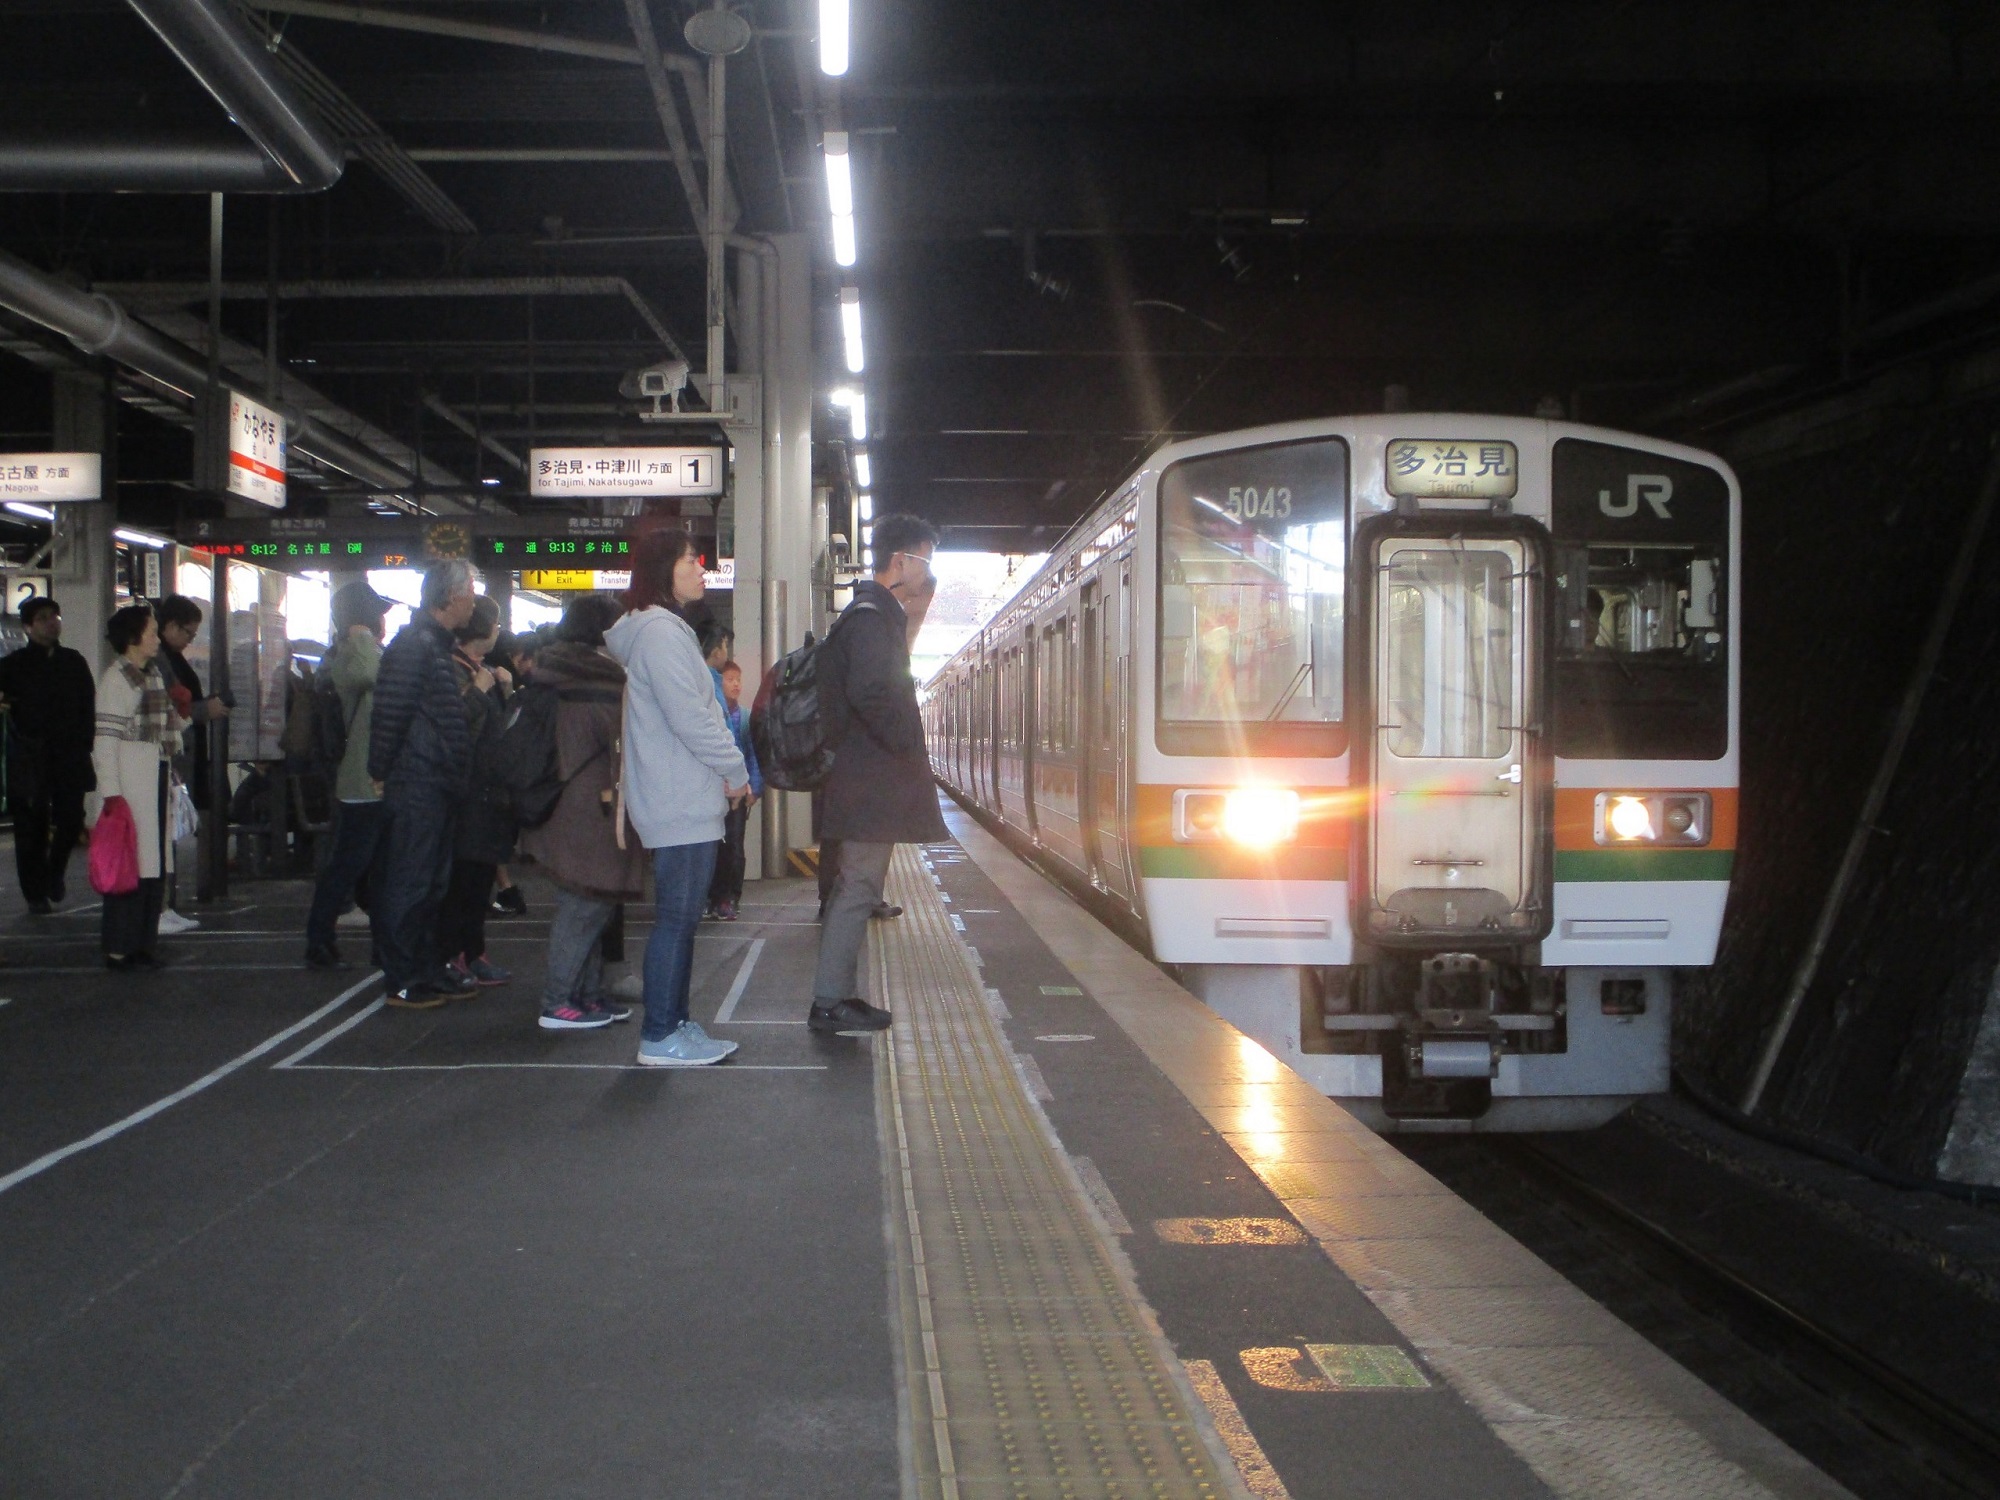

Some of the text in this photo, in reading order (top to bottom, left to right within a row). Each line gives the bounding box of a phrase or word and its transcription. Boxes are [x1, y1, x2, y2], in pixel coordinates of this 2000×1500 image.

[538, 459, 673, 475] 多治見・中津川 方面
[1393, 445, 1511, 477] 多治見
[46, 467, 70, 478] 方面
[687, 459, 700, 483] 1
[5, 484, 39, 492] Nagoya
[538, 478, 654, 488] for Tajimi, Nakatsugawa
[1227, 487, 1292, 519] 5043
[1599, 474, 1673, 519] JR
[251, 544, 278, 555] 9:12
[287, 543, 331, 555] 名古屋
[494, 542, 629, 553] 普通 9:13 多治見
